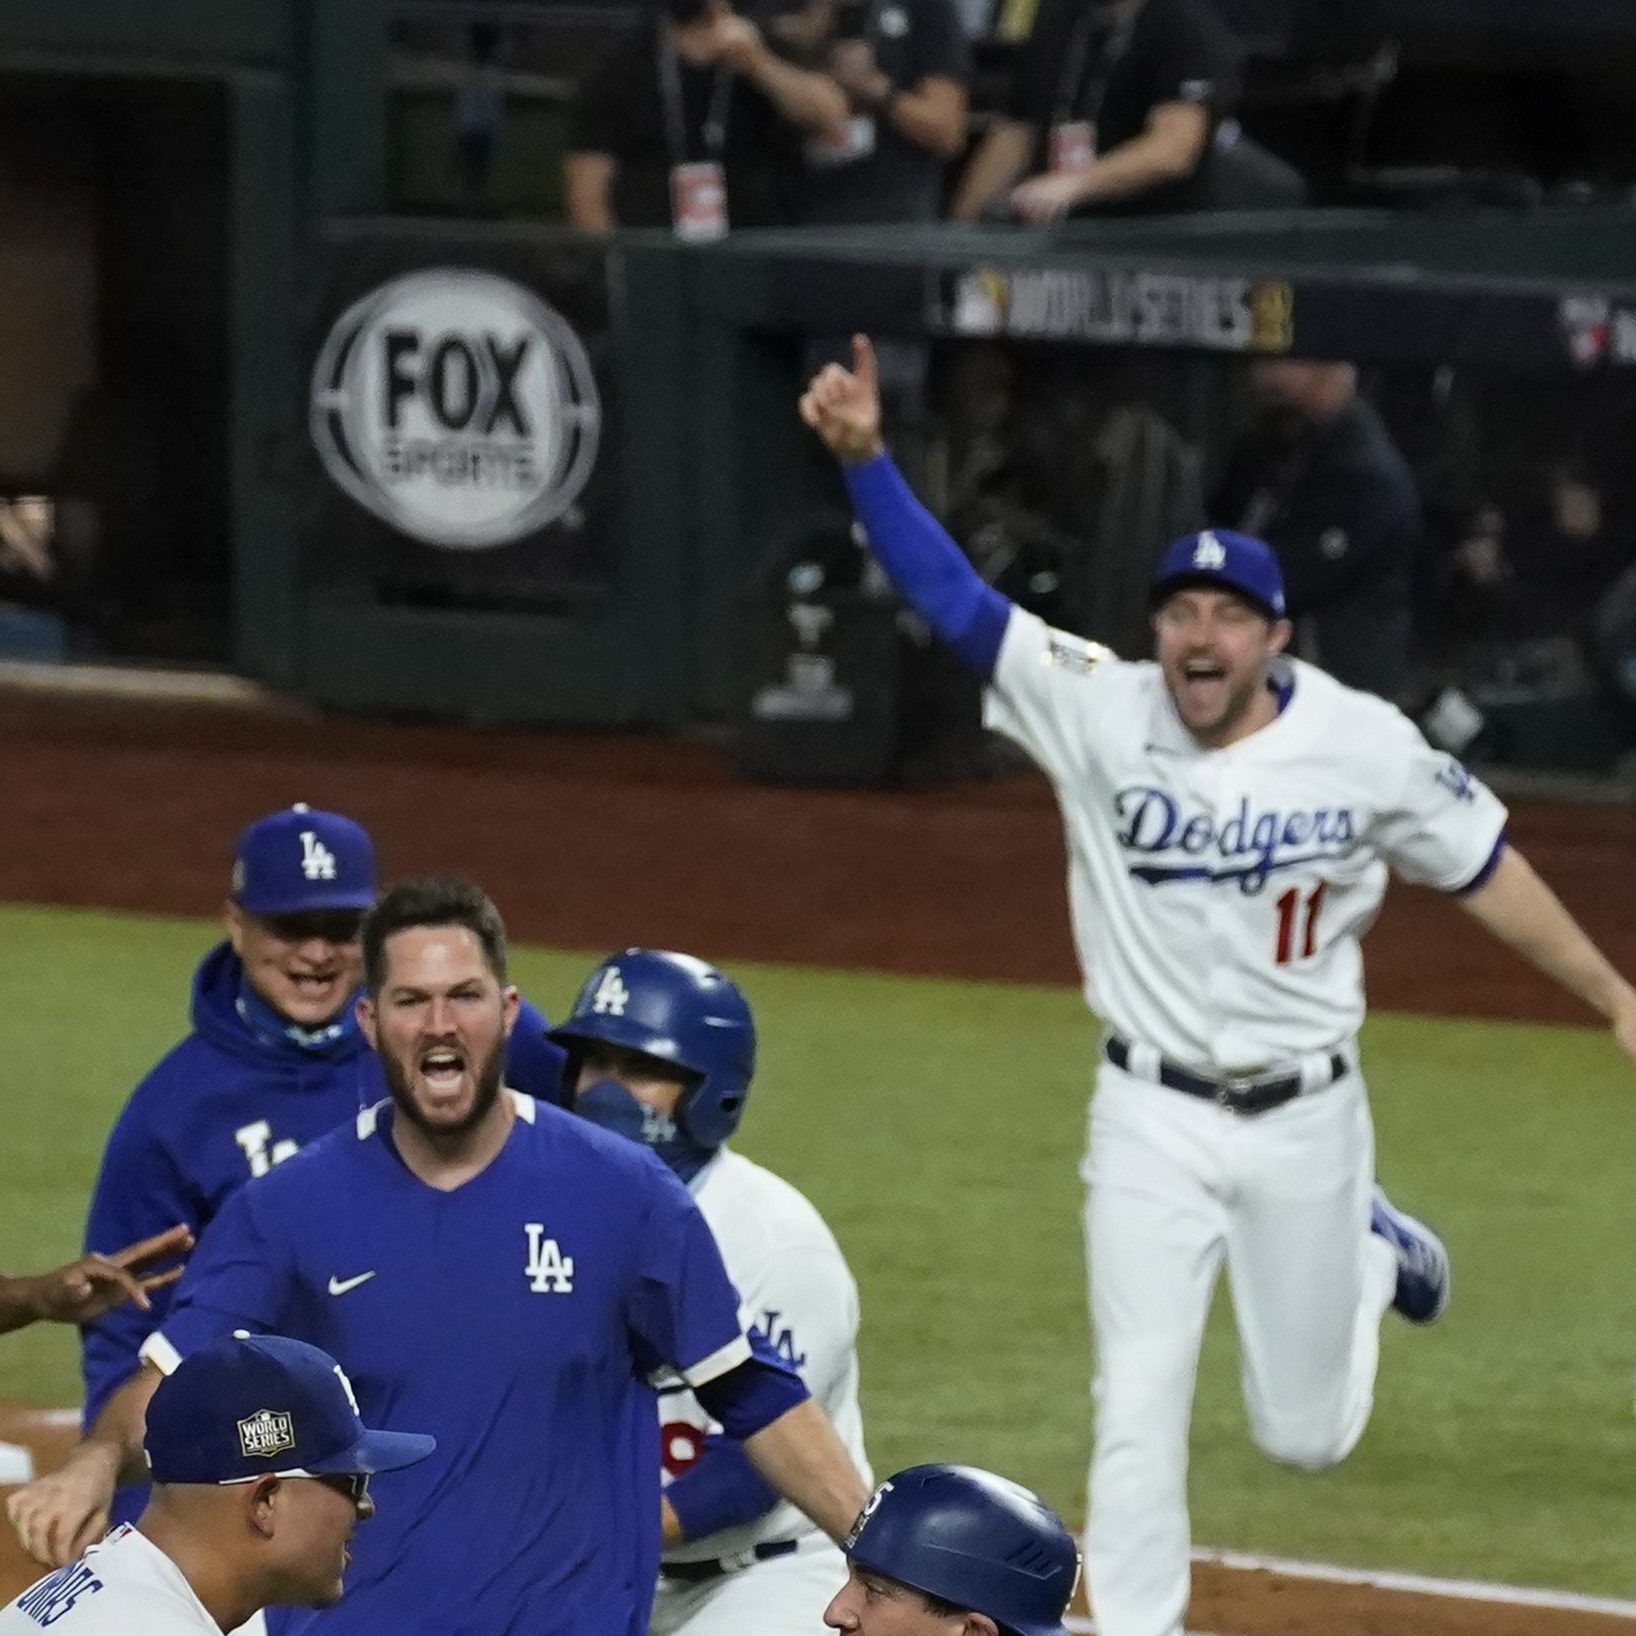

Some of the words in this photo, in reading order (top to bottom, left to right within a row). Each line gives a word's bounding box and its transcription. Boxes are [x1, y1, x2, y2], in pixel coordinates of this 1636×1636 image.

[383, 329, 531, 437] FOX
[299, 831, 337, 880] LA
[1116, 784, 1360, 895] Dodgers
[1275, 880, 1326, 965] 11
[592, 966, 630, 1016] LA
[524, 1223, 574, 1293] LA
[243, 1417, 288, 1437] WORLD
[245, 1431, 290, 1450] SERIES
